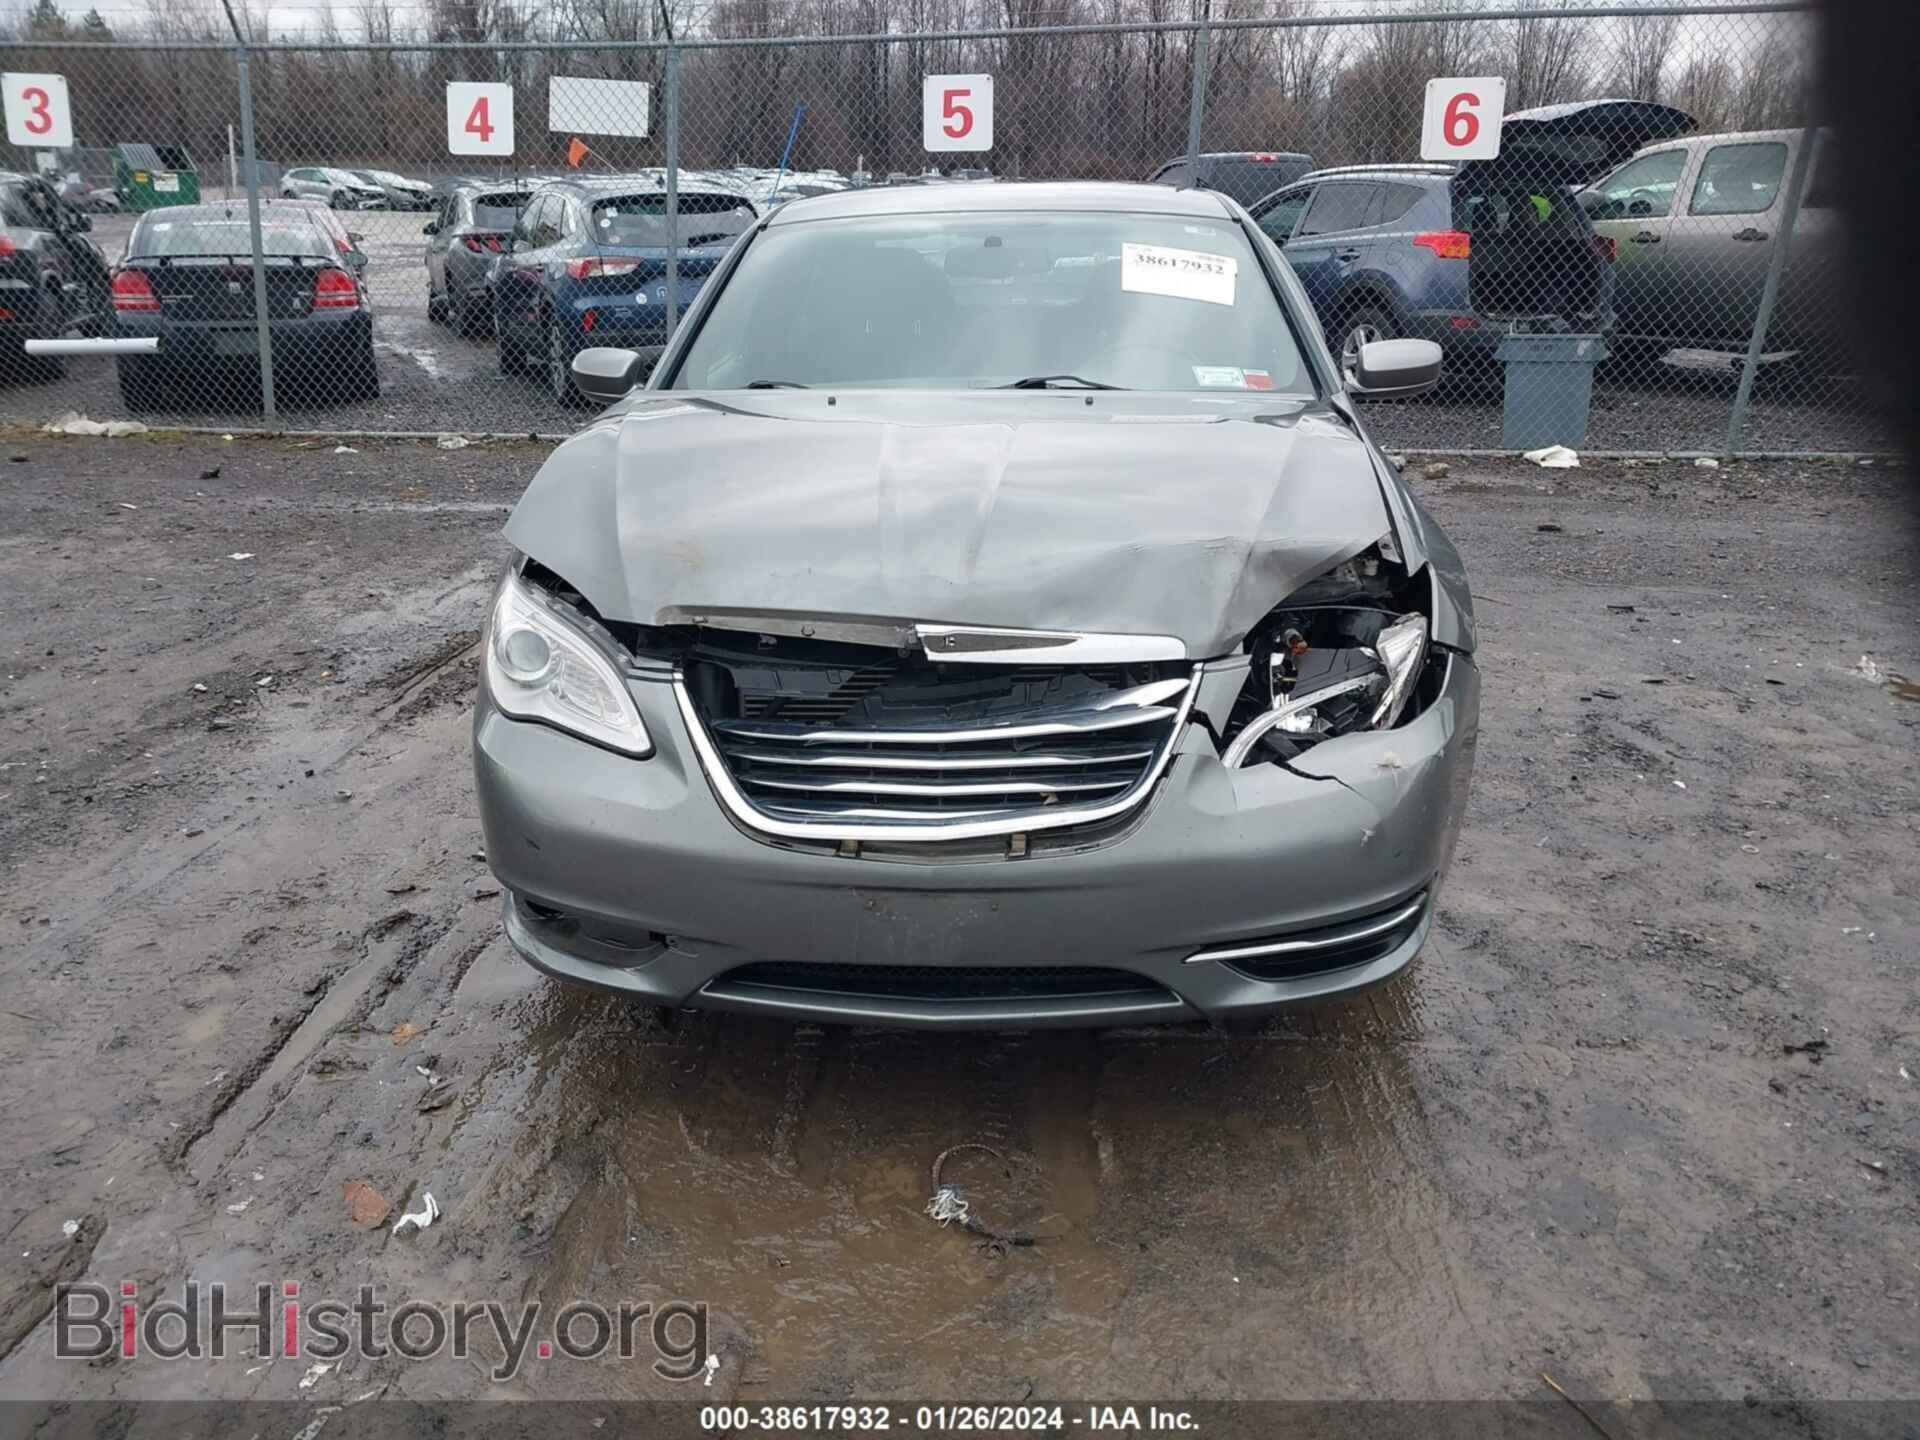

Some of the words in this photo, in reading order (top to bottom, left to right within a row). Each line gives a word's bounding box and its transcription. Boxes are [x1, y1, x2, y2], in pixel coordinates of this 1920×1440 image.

[22, 87, 53, 134] 3
[464, 97, 494, 142] 4
[942, 89, 975, 139] 5
[1443, 92, 1481, 147] 6
